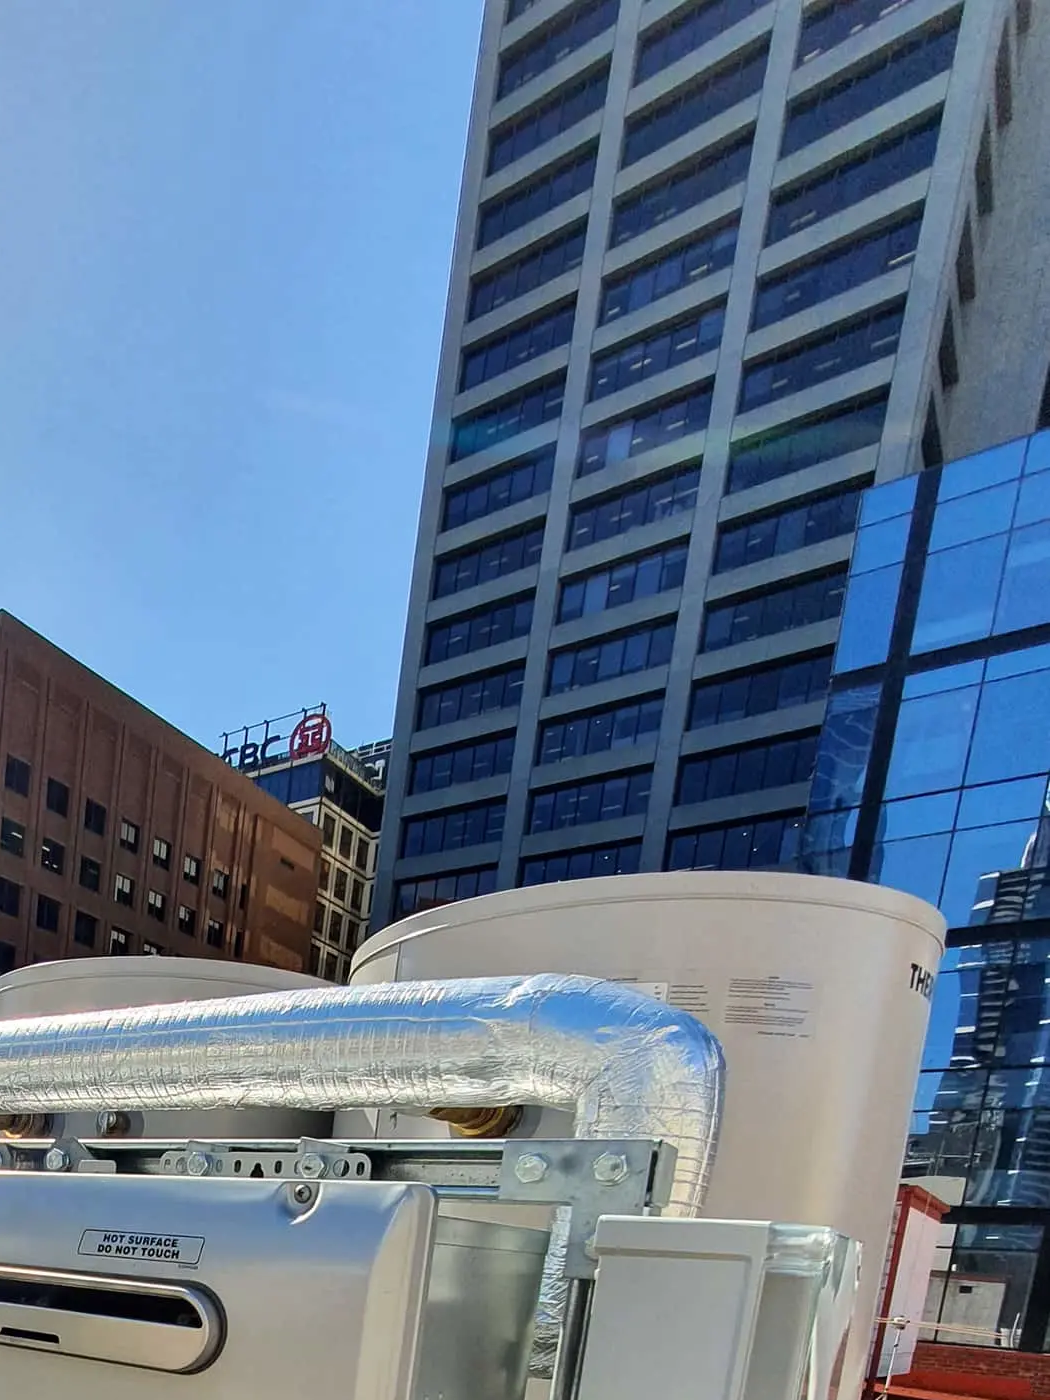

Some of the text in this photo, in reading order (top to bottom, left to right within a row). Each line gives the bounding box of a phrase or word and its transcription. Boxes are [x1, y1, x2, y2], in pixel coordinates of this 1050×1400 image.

[103, 1233, 179, 1248] HOT SURFACE
[97, 1244, 180, 1259] DO NOT TOUCH
